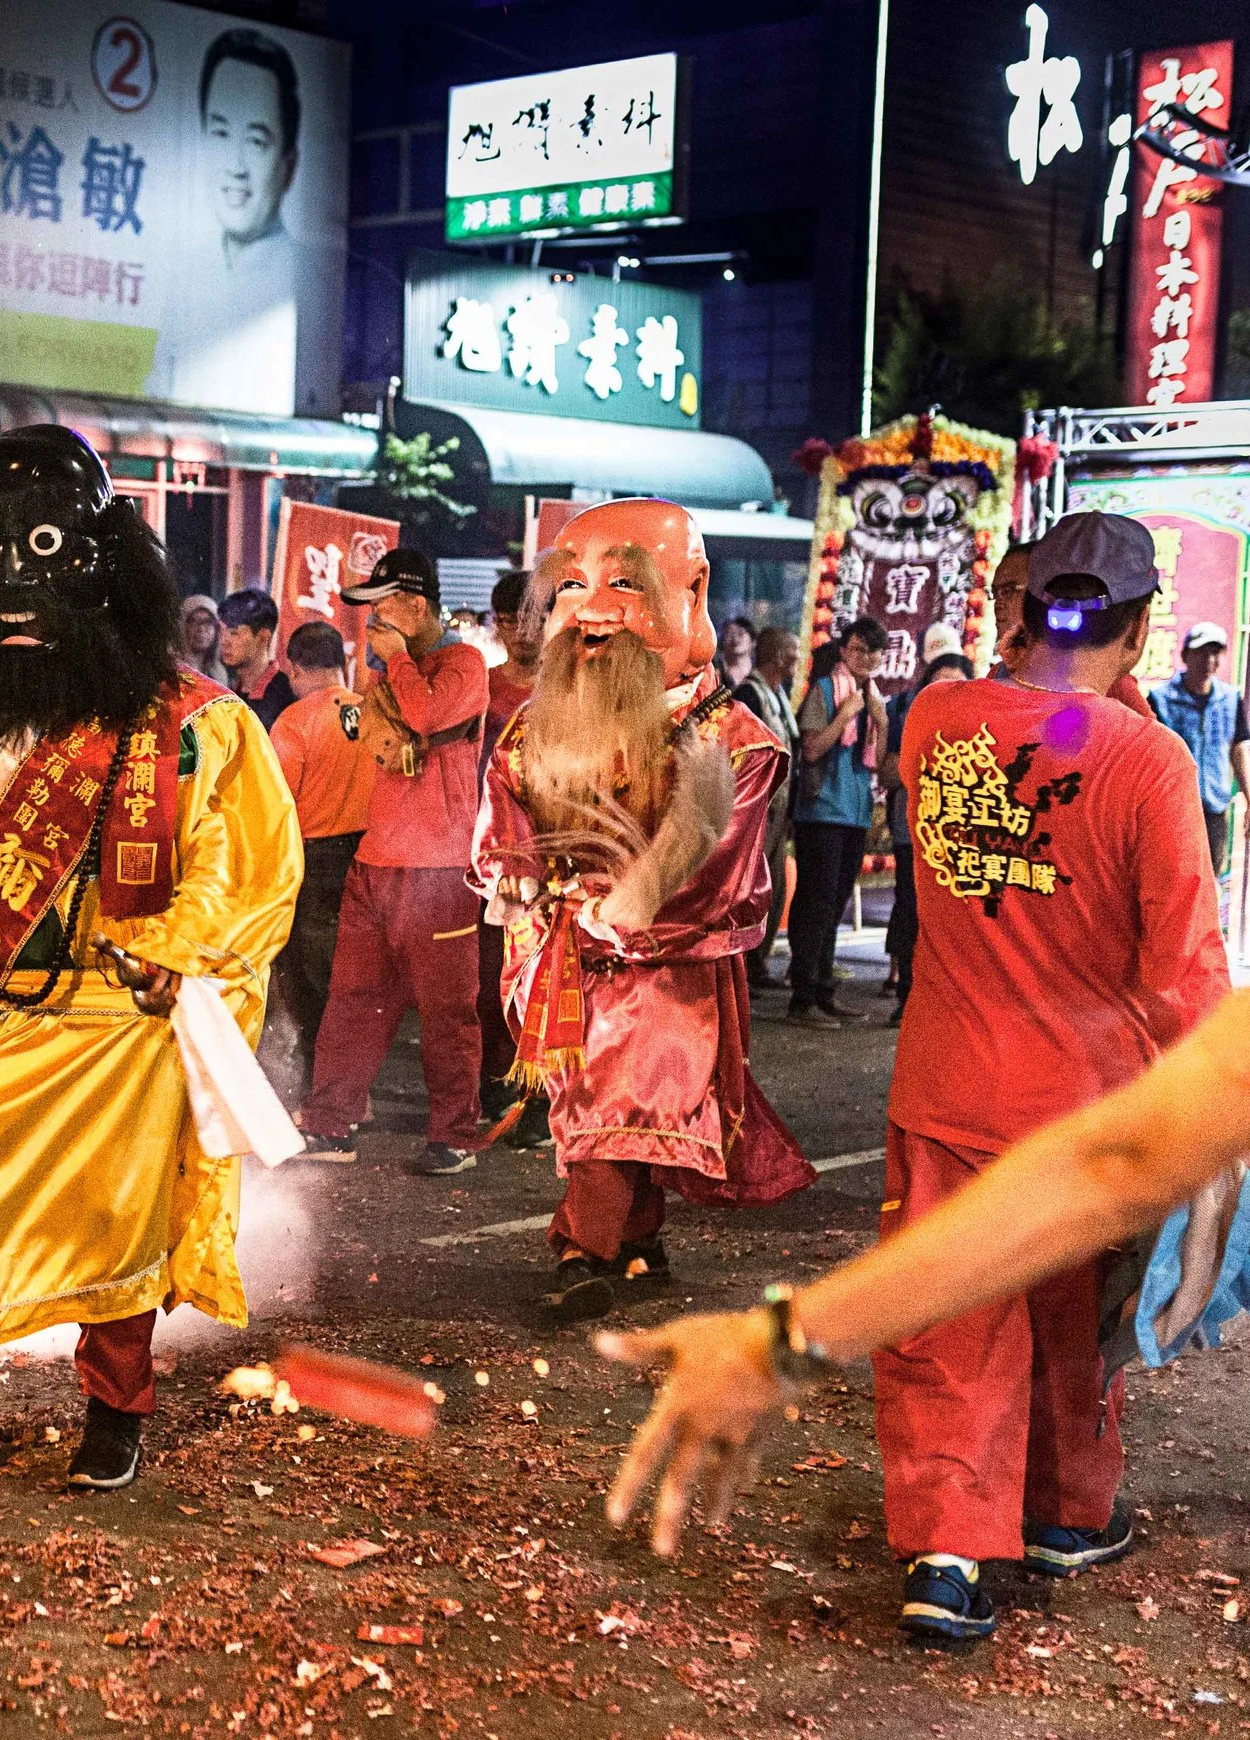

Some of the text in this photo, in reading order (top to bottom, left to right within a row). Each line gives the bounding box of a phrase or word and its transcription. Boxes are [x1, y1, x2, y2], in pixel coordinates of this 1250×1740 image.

[108, 27, 141, 98] 2
[956, 849, 1057, 895] 祀宴團隊
